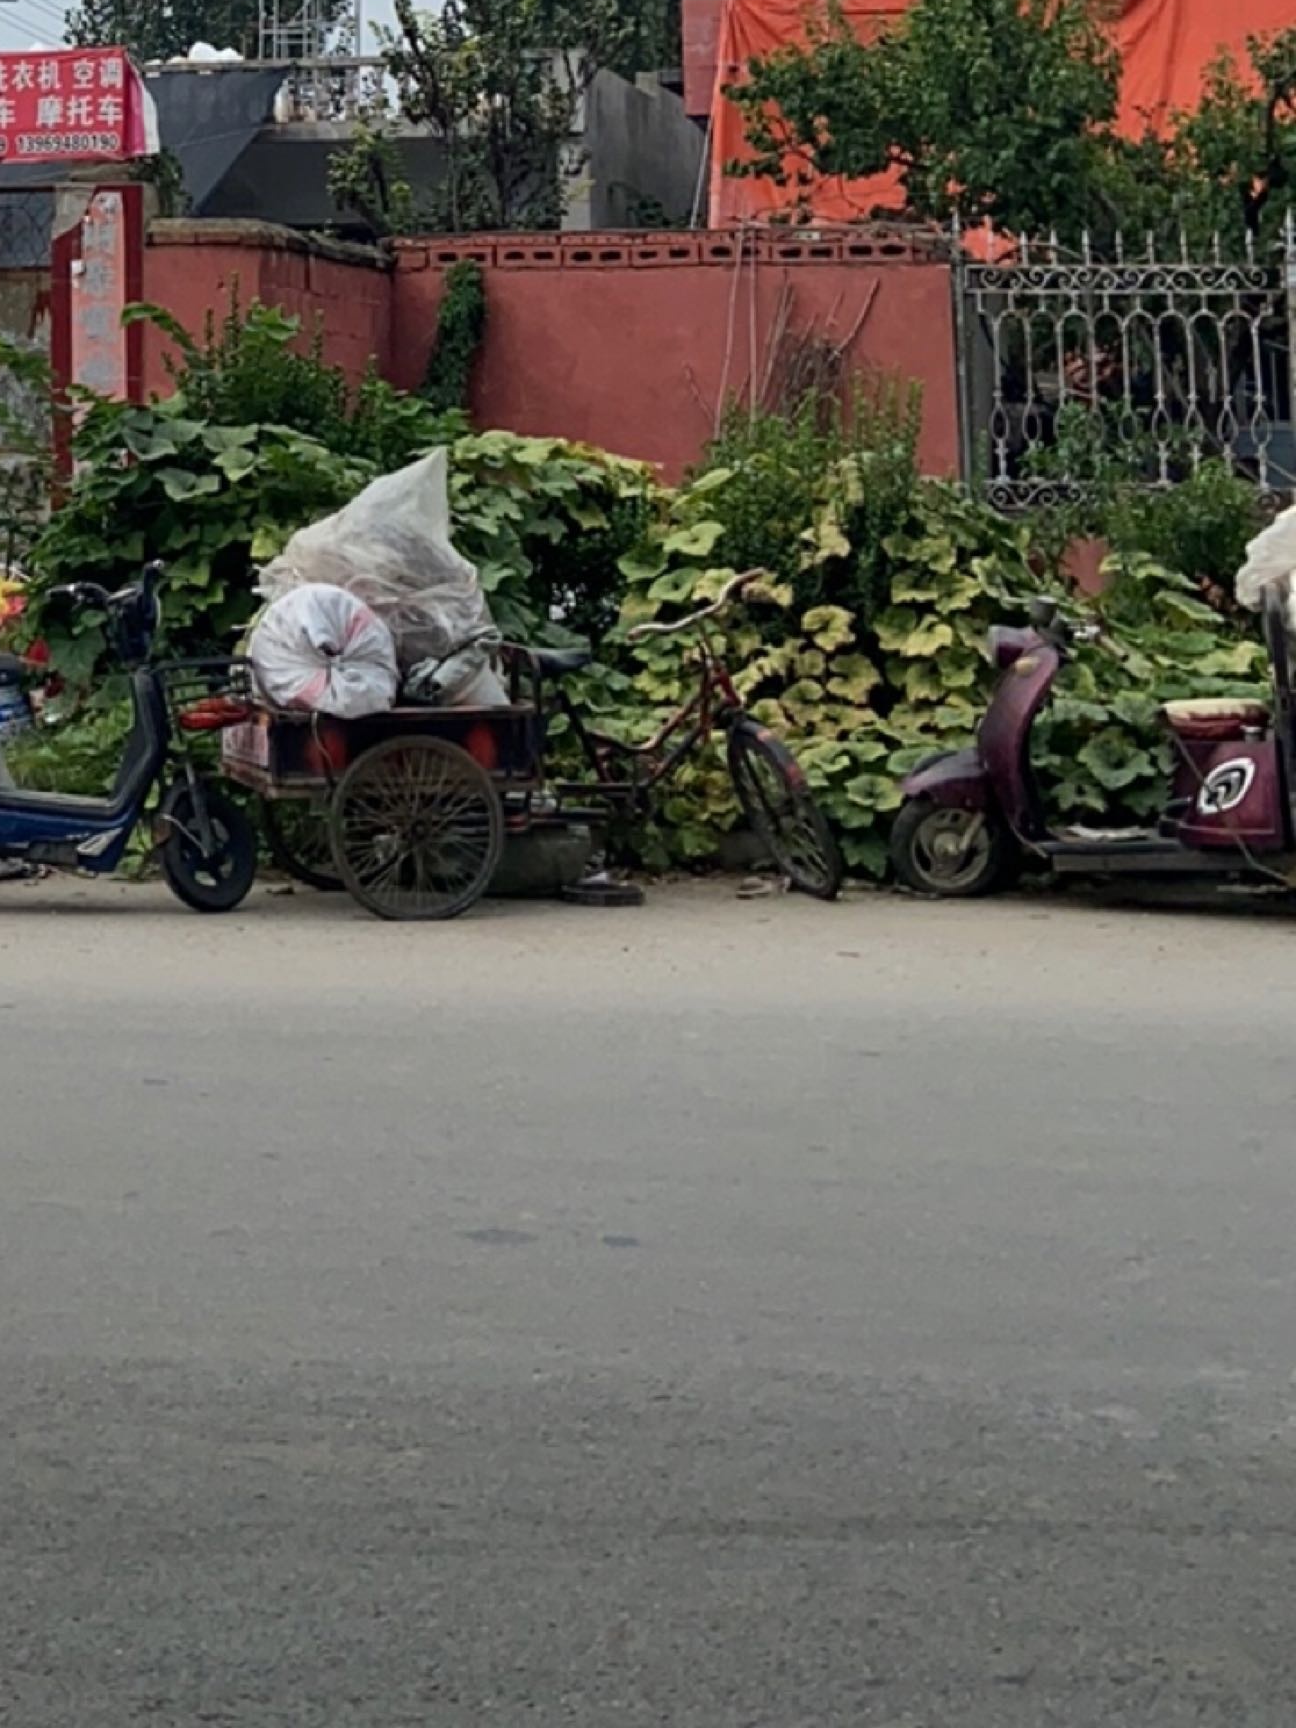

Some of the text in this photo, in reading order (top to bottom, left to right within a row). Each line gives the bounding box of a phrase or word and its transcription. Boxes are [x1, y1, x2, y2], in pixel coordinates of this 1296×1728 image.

[72, 57, 124, 89] 空调
[36, 95, 123, 127] 摩托车
